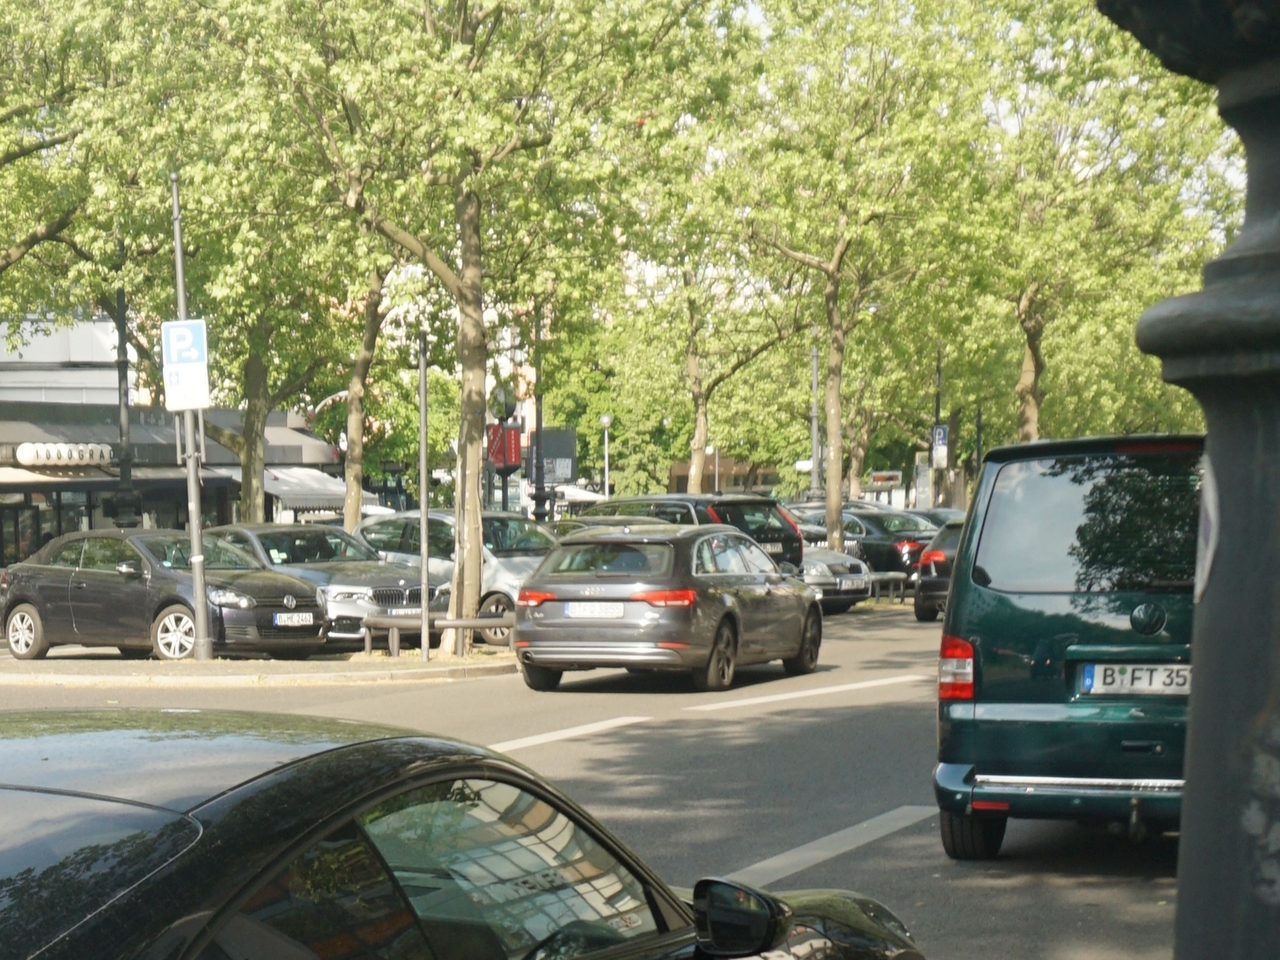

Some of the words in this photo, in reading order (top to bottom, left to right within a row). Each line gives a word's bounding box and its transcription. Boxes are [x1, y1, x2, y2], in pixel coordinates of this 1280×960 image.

[170, 327, 193, 362] P
[1102, 667, 1116, 686] B
[1130, 667, 1158, 686] FT
[1162, 667, 1192, 687] 35
